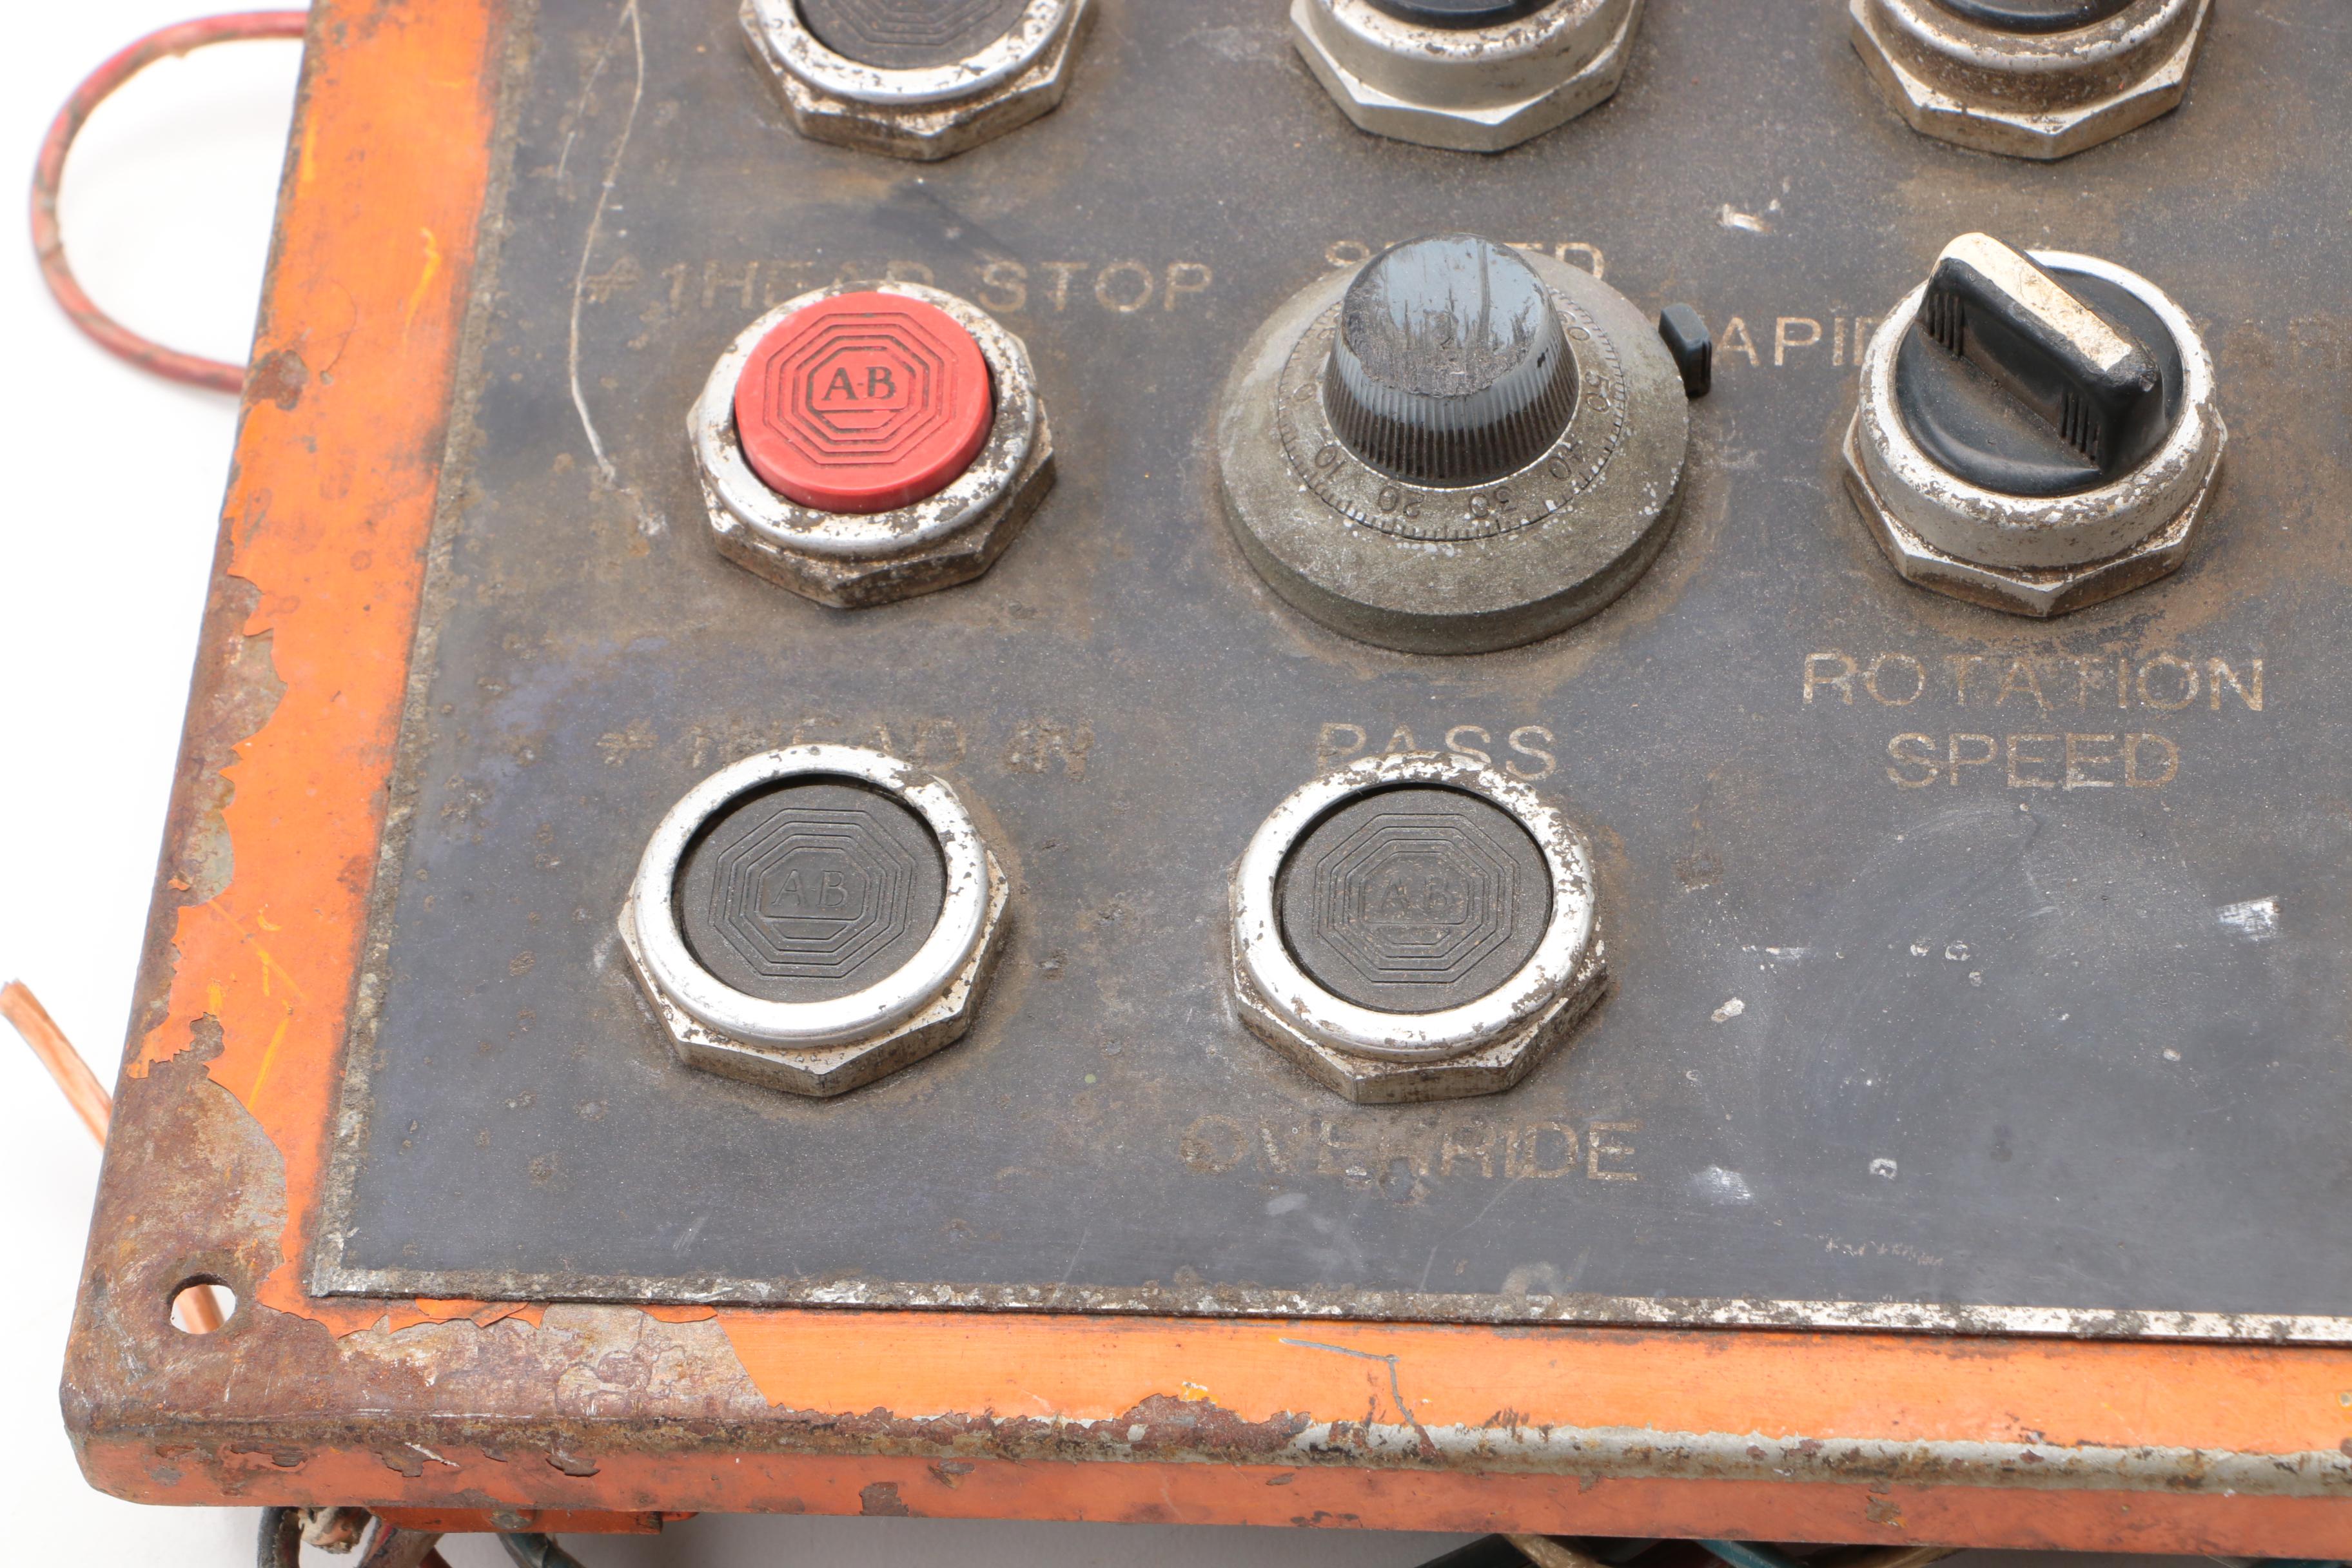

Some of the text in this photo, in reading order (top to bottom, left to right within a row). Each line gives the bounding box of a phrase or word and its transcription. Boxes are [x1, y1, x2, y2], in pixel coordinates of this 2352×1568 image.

[978, 259, 1212, 313] STOP
[1711, 315, 1890, 368] API
[821, 366, 897, 401] A-B
[1803, 652, 2263, 712] ROTATION
[1317, 721, 1557, 781] PASS
[1885, 732, 2180, 789] SPEED
[1179, 1113, 1644, 1181] OVERIDE
